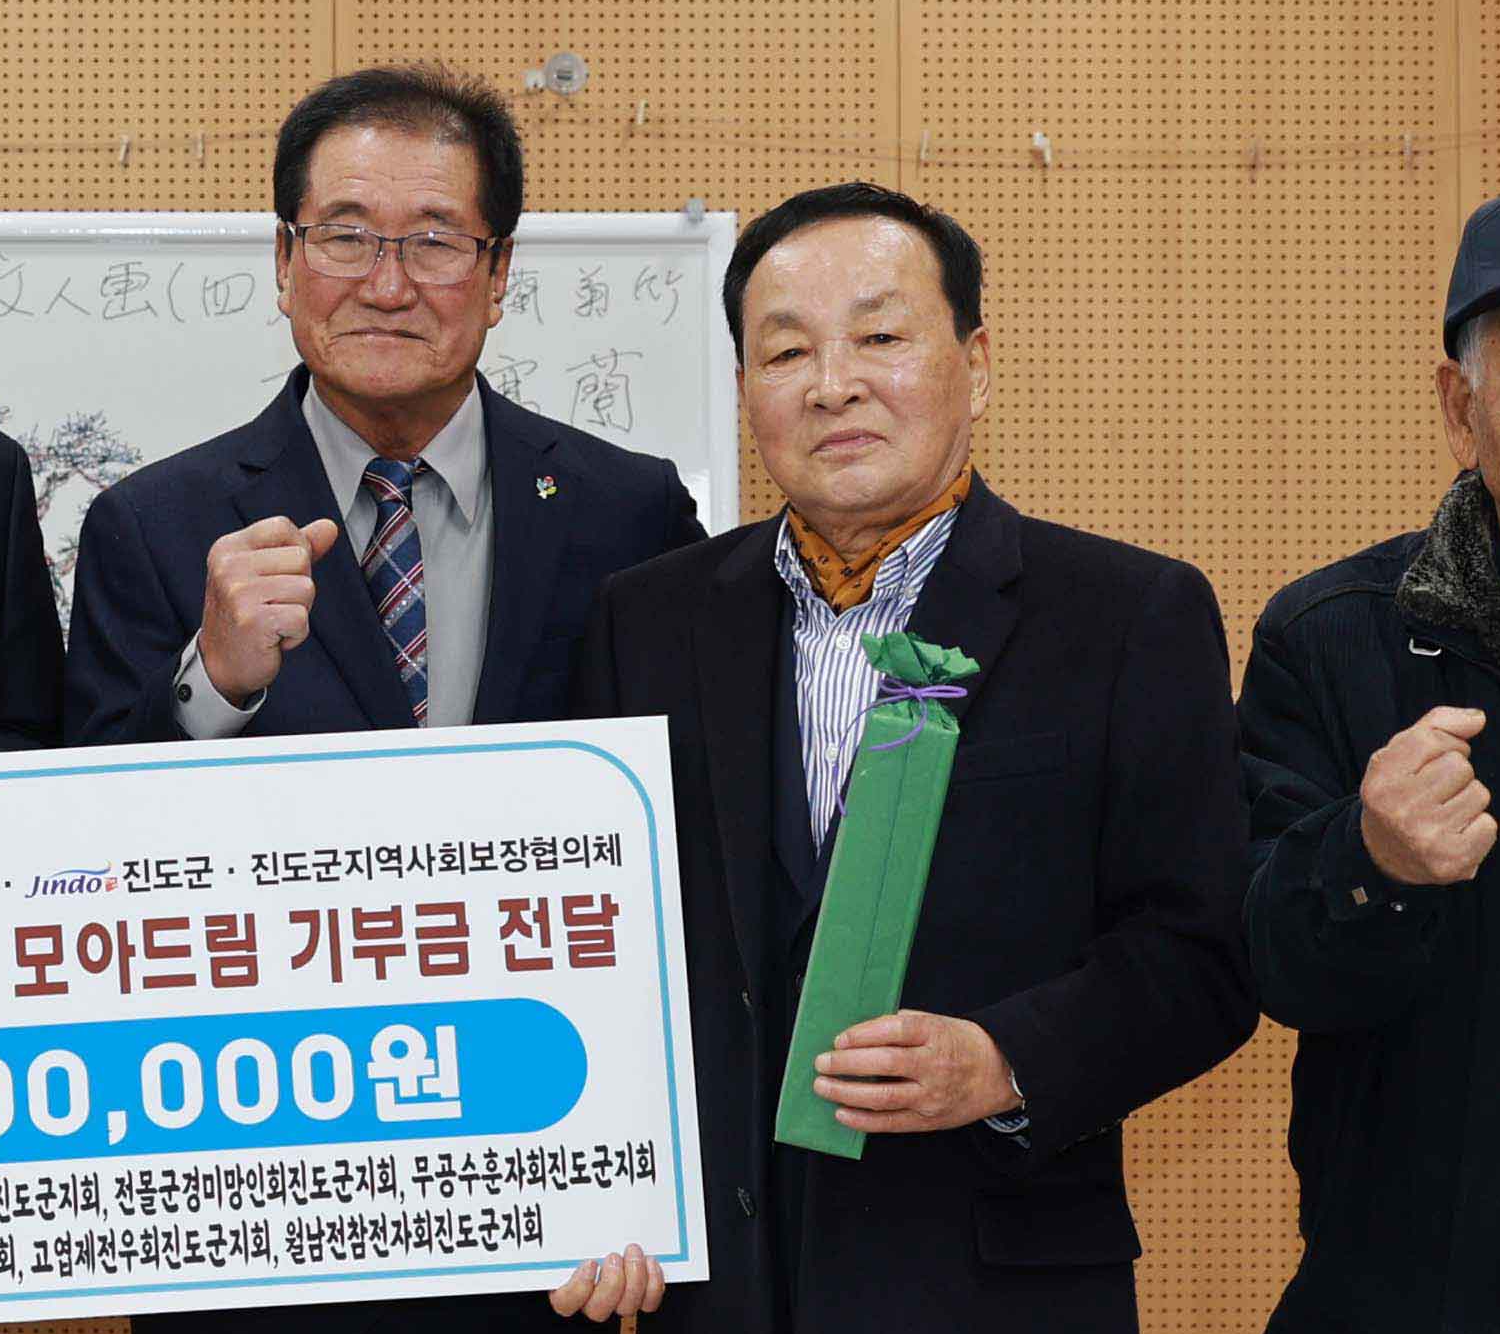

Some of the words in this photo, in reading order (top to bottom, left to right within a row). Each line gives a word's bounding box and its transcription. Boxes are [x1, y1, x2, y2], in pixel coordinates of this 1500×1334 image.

[24, 874, 103, 899] Jindo
[121, 854, 215, 894] 진도군
[250, 831, 623, 888] 진도군지역사회보장협의체
[14, 911, 260, 998] 모아드림
[289, 901, 470, 983] 기부금
[497, 893, 620, 973] 전달
[113, 1153, 405, 1216] 전몰군경미망인회진도군지회,
[411, 1139, 656, 1199] 무공수훈자회진도군지회
[31, 1214, 280, 1277] 고엽제전우회진도군지회,
[285, 1202, 544, 1264] 월남전참전자회진도군지회
